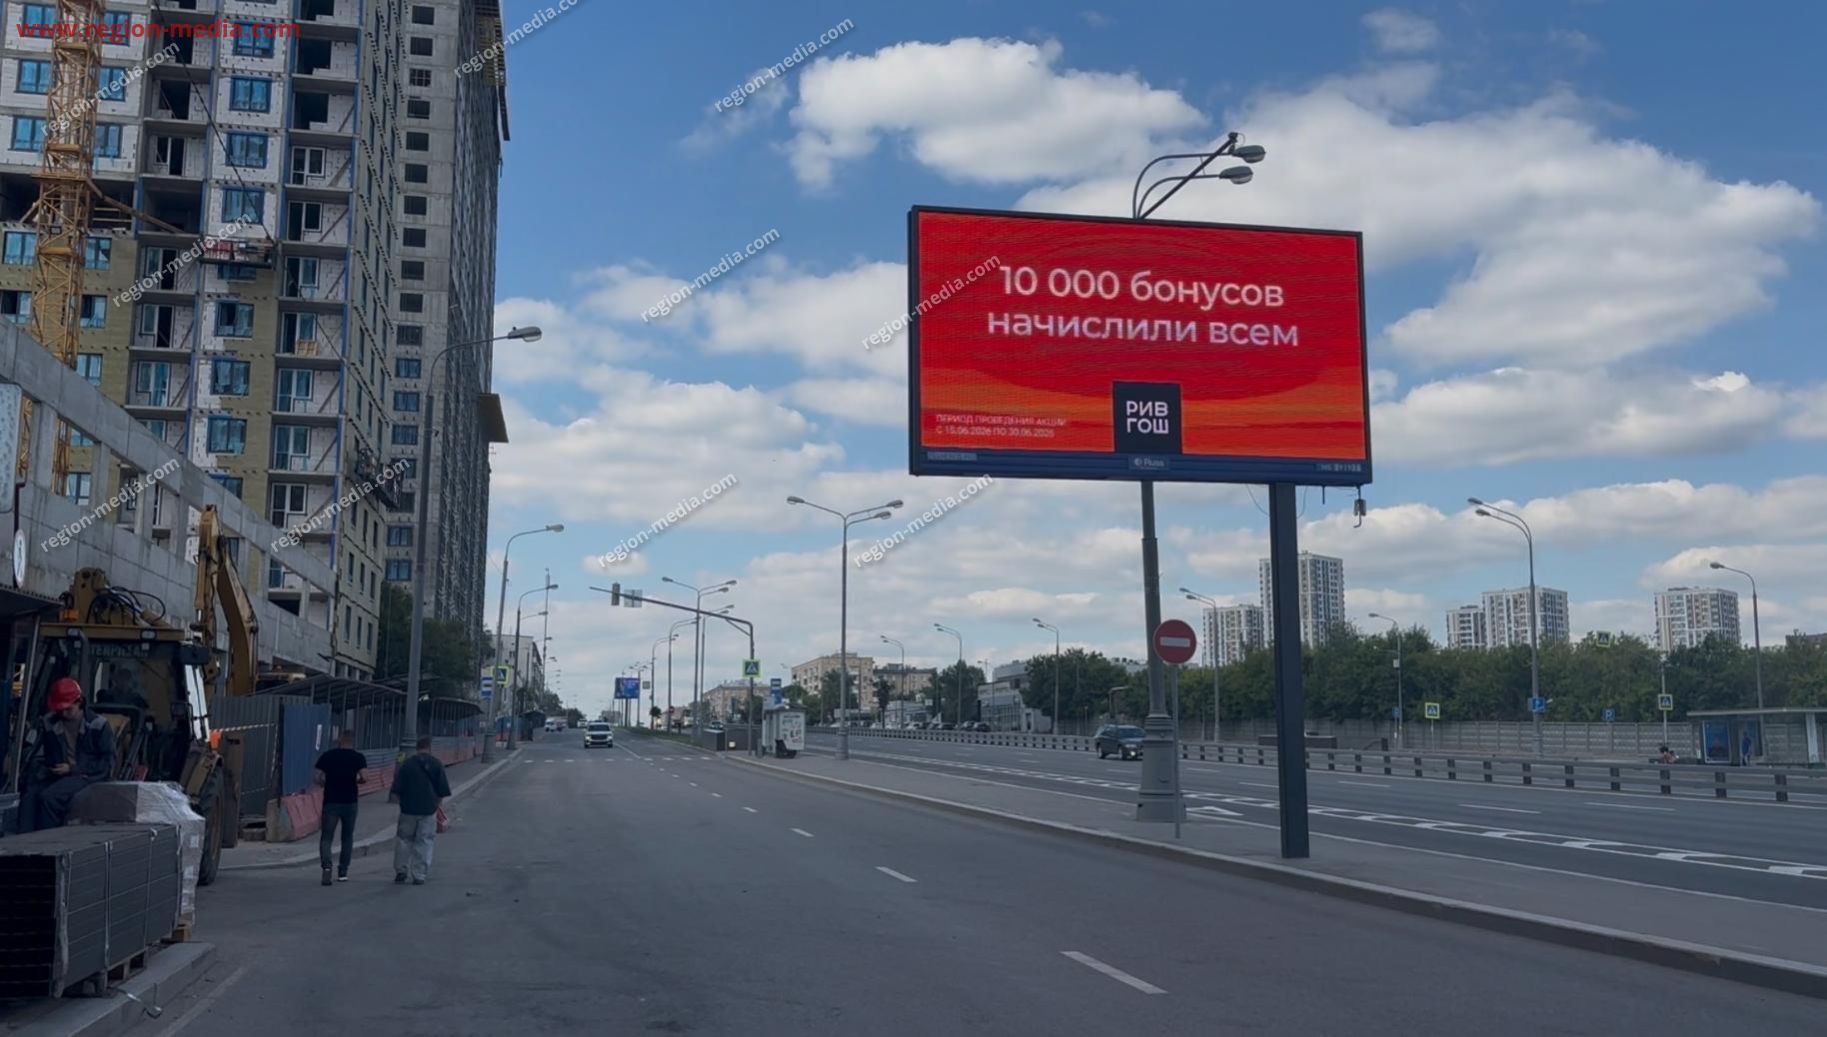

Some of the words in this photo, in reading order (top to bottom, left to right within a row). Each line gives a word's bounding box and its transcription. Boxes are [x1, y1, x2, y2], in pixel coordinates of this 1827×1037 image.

[1000, 266, 1038, 296] 10
[1048, 268, 1121, 300] 000
[1130, 270, 1285, 312] бонусов
[987, 312, 1198, 343] начислили
[1209, 321, 1299, 347] всем
[1126, 400, 1169, 417] РИВ
[936, 414, 973, 425] ПЕРИОД
[976, 415, 1034, 426] ПРОВЕДЕНИЯ
[1126, 418, 1169, 434] ГОШ
